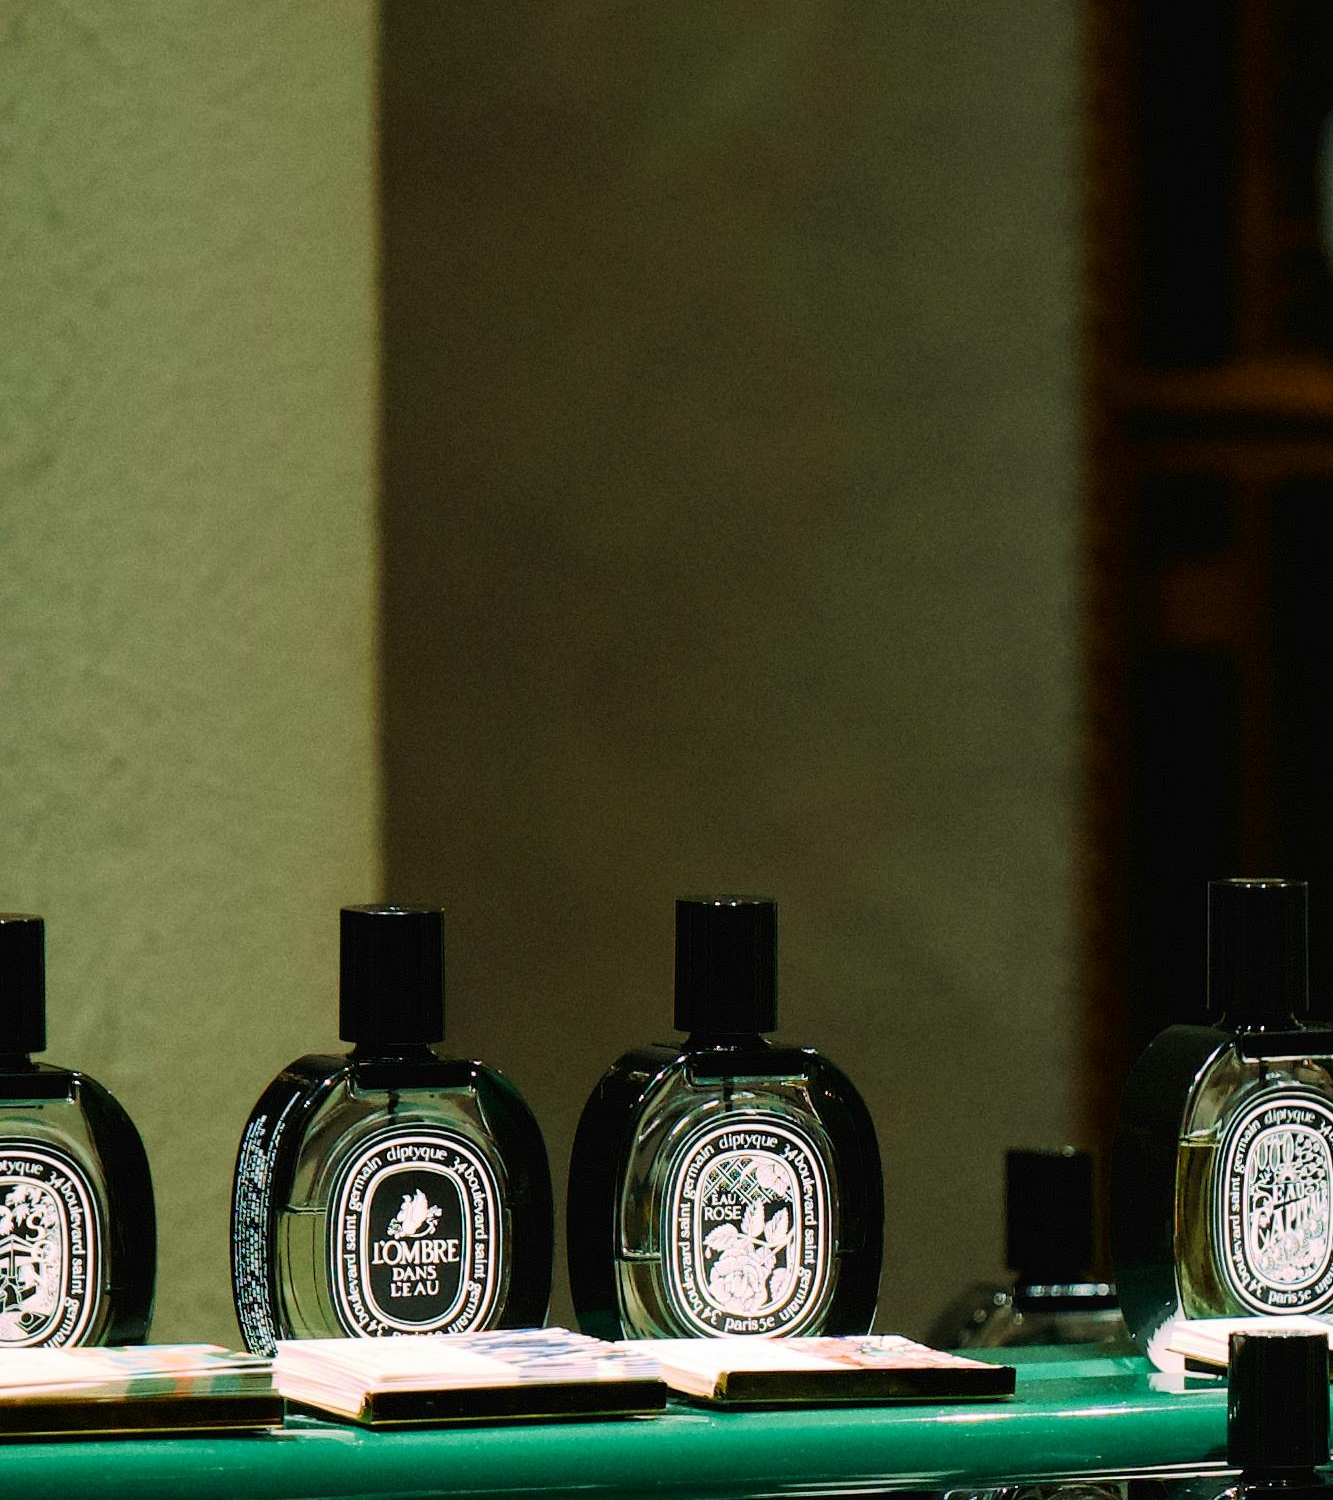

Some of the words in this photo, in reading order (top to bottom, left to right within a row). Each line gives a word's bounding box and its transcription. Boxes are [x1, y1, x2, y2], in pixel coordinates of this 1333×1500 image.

[1264, 1108, 1316, 1125] diptyque
[387, 1146, 448, 1162] diptyque
[719, 1133, 778, 1149] diptyque
[1233, 1120, 1261, 1174] germain
[349, 1156, 382, 1212] germain
[683, 1145, 714, 1199] germain
[711, 1193, 736, 1204] EAU
[1229, 1177, 1241, 1212] saint
[679, 1203, 691, 1238] saint
[704, 1206, 742, 1221] ROSE
[344, 1214, 357, 1250] saint
[804, 1229, 817, 1264] saint
[372, 1239, 459, 1265] L'OMBRE
[474, 1243, 487, 1279] saint
[72, 1257, 84, 1294] saint
[392, 1266, 437, 1280] DANS
[448, 1281, 482, 1334] germain
[780, 1266, 812, 1320] germain
